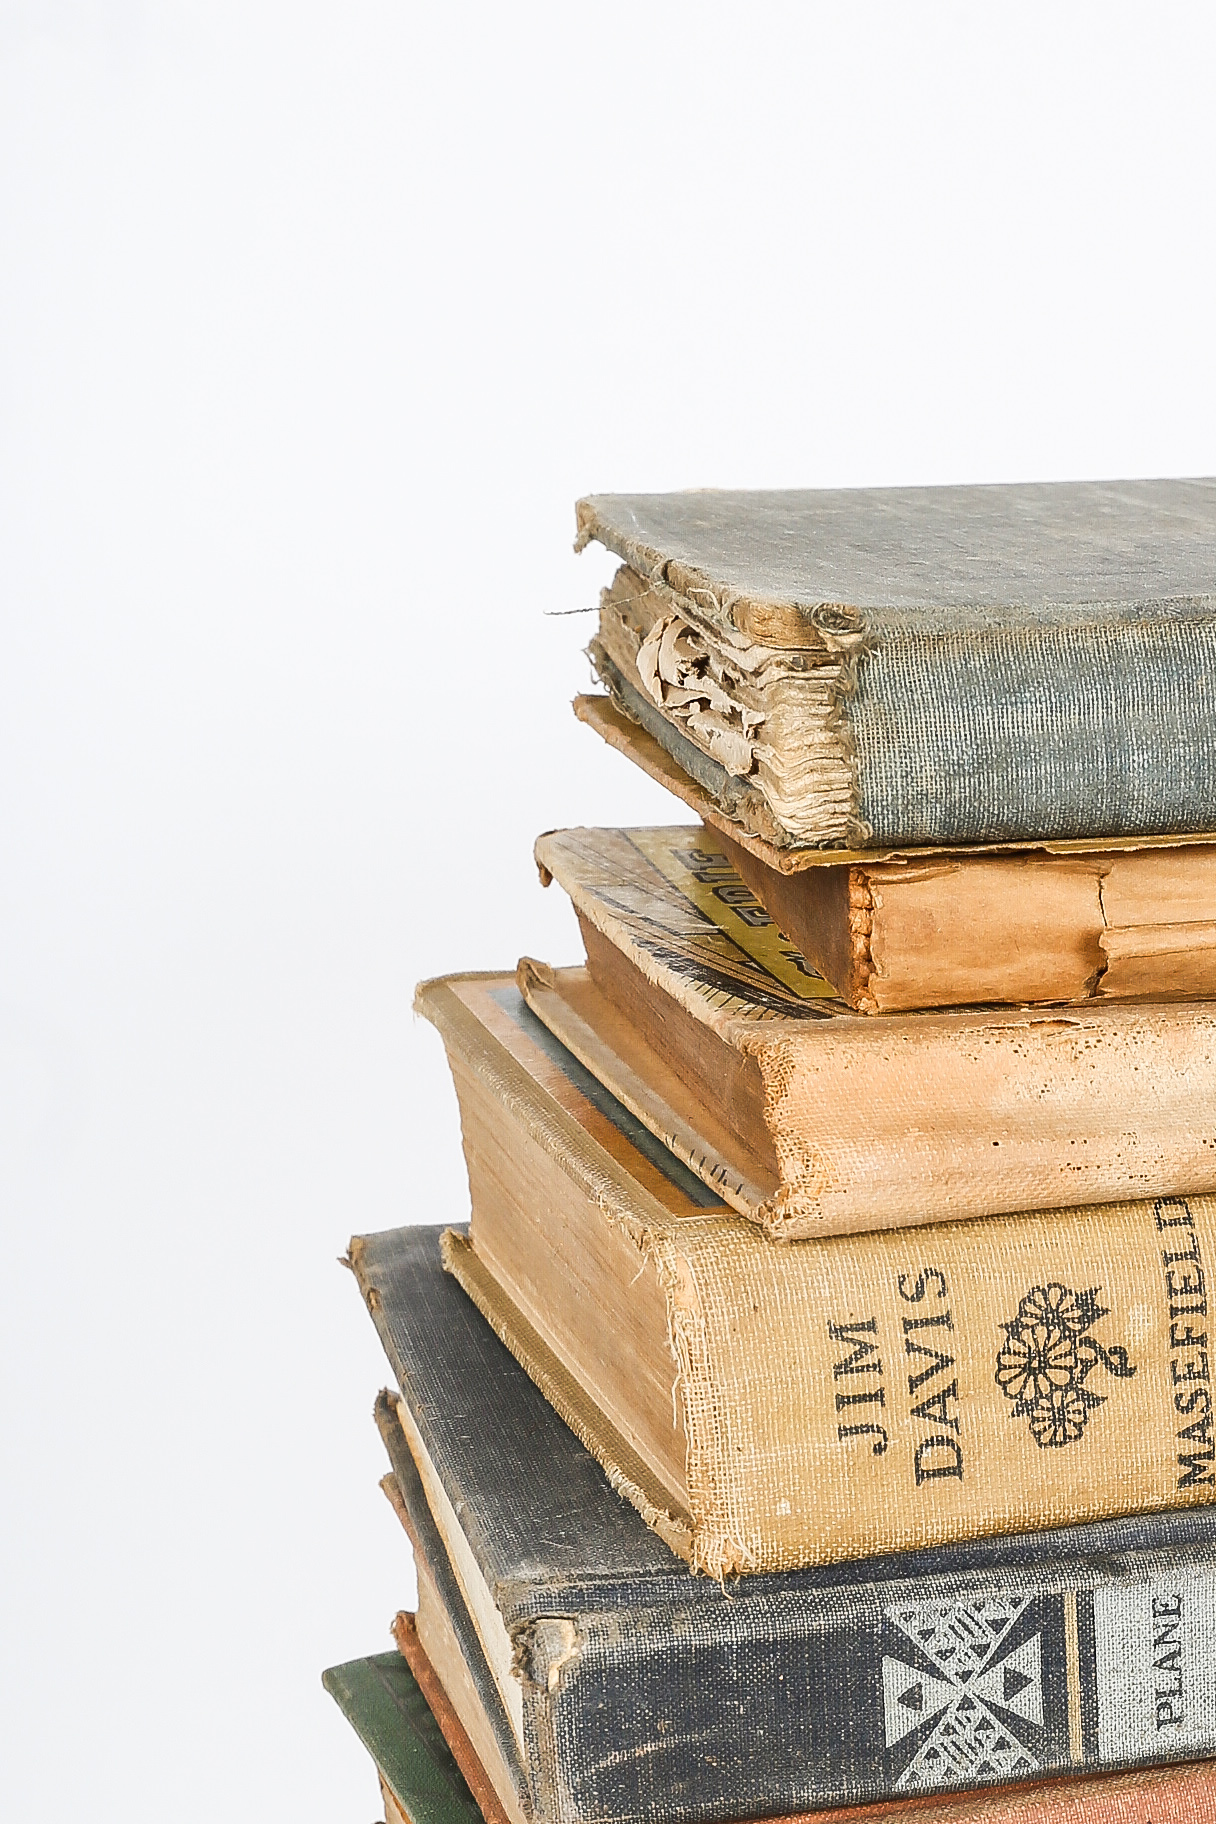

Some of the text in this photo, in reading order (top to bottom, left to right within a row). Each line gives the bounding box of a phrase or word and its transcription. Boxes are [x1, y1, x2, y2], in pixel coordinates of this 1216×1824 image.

[828, 1314, 888, 1455] JIM
[898, 1267, 963, 1485] DAVIS
[1153, 1196, 1216, 1489] MASEFIELD
[1151, 1592, 1183, 1732] PLANE
